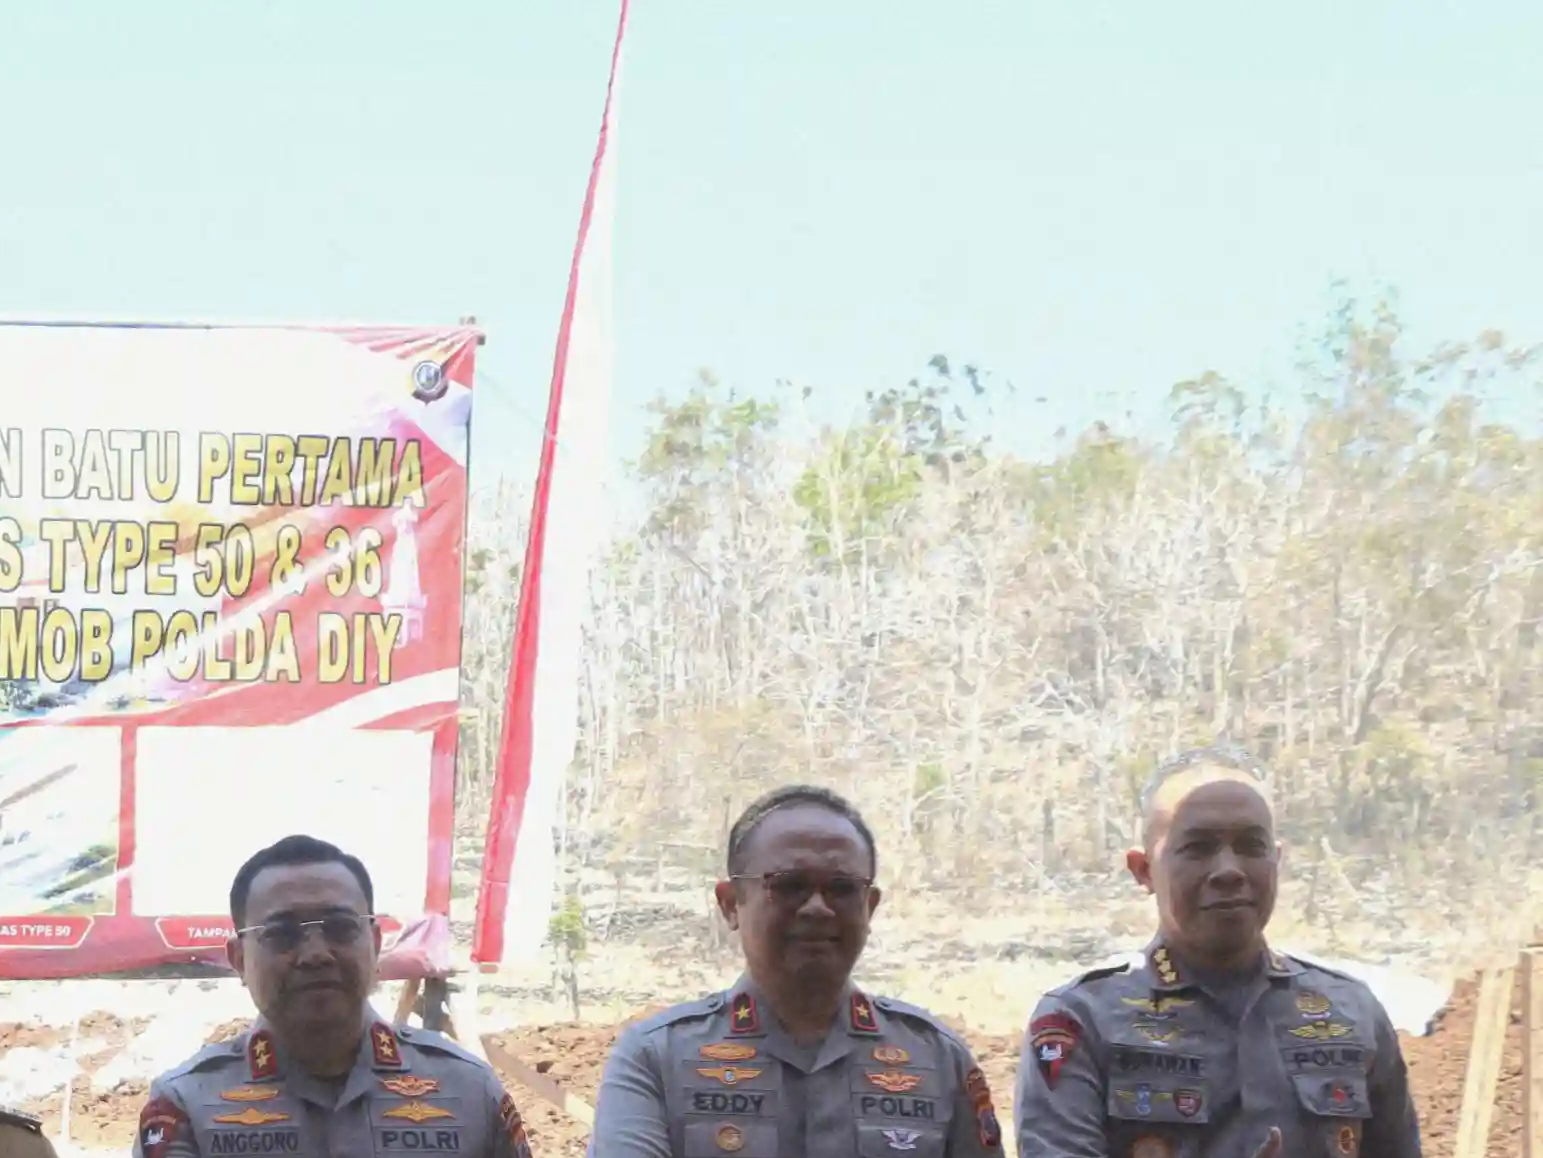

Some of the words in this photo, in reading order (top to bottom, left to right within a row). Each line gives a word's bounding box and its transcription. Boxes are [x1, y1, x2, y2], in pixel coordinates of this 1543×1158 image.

[41, 428, 180, 501] BATU
[198, 432, 426, 508] PERTAMA
[40, 518, 178, 595] TYPE
[193, 523, 256, 598] 50
[270, 524, 306, 596] &
[324, 526, 383, 598] 36
[132, 609, 301, 683] POLDA
[317, 612, 403, 685] DIY
[21, 924, 53, 937] TYPE
[692, 1092, 765, 1115] EDDY
[861, 1096, 934, 1118] POLRI
[210, 1130, 300, 1153] ANGGORO
[381, 1129, 460, 1151] POLRI
